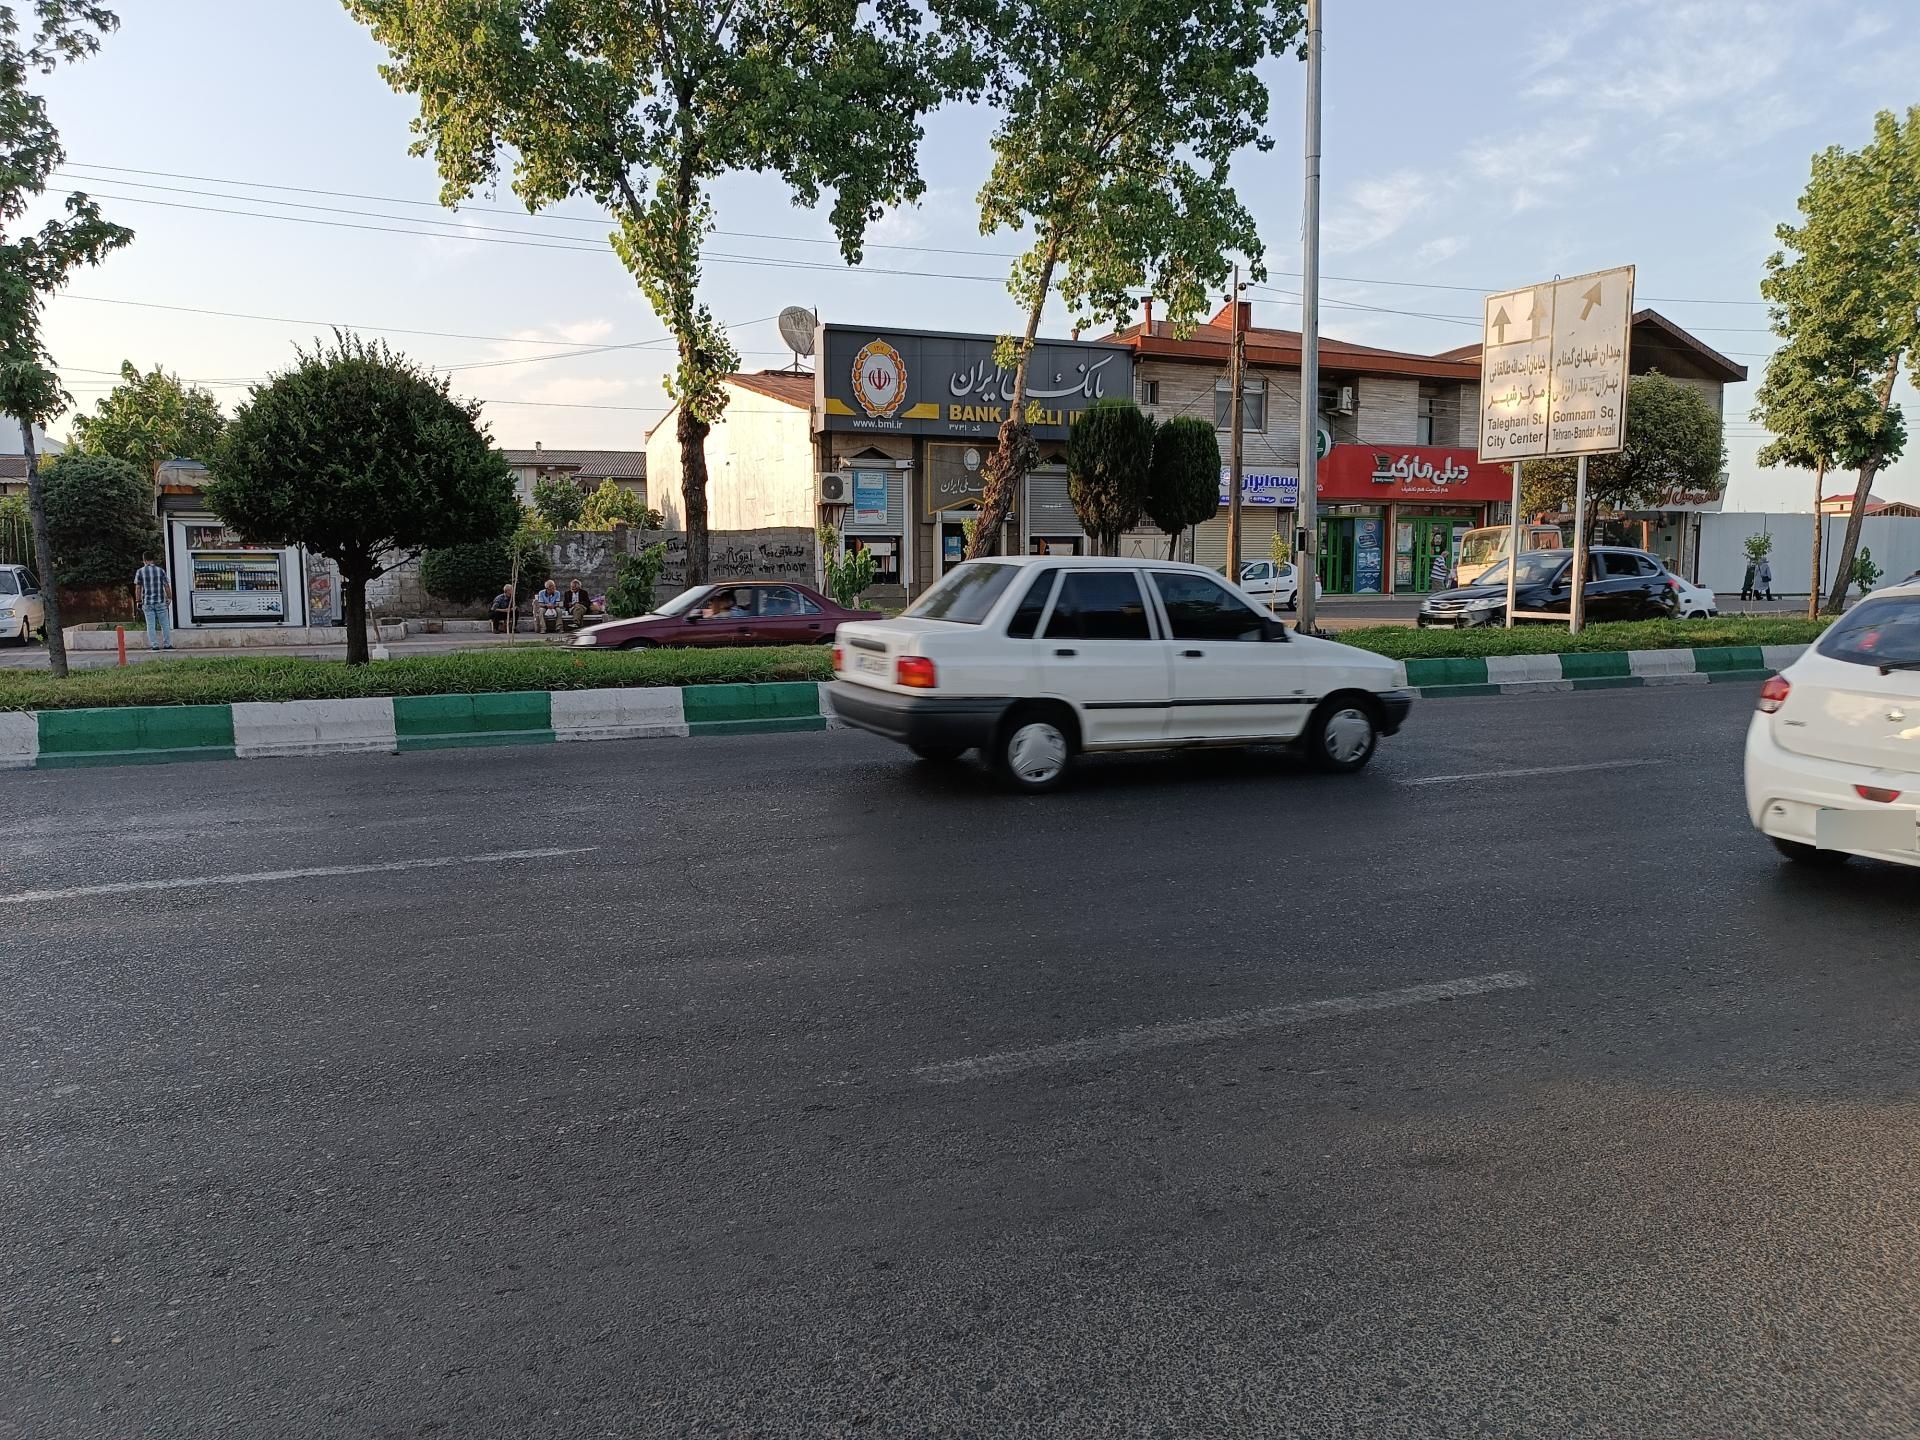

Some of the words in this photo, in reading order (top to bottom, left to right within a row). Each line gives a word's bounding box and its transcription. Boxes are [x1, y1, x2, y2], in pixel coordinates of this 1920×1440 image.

[1556, 347, 1575, 377] گمنام
[1574, 344, 1599, 368] شهدای
[1600, 343, 1621, 366] میدان
[1489, 360, 1511, 383] طالقانی
[1529, 354, 1546, 376] خیابان
[950, 359, 1002, 402] ایران
[1487, 384, 1518, 410] شهر
[1517, 383, 1546, 407] مرکز
[949, 404, 1003, 423] BANK
[1487, 414, 1530, 432] Taleghani
[1532, 412, 1544, 425] St.
[1552, 409, 1596, 423] Gomnam
[1600, 405, 1617, 421] Sq.
[852, 419, 903, 430] www.bmi.ir
[948, 423, 967, 431] ۳۷۳۱
[971, 423, 981, 432] کد
[1596, 423, 1617, 437] Anzali
[1486, 434, 1506, 449] City
[1509, 431, 1544, 445] Center
[940, 478, 960, 495] ایران
[1269, 474, 1298, 494] بیمه
